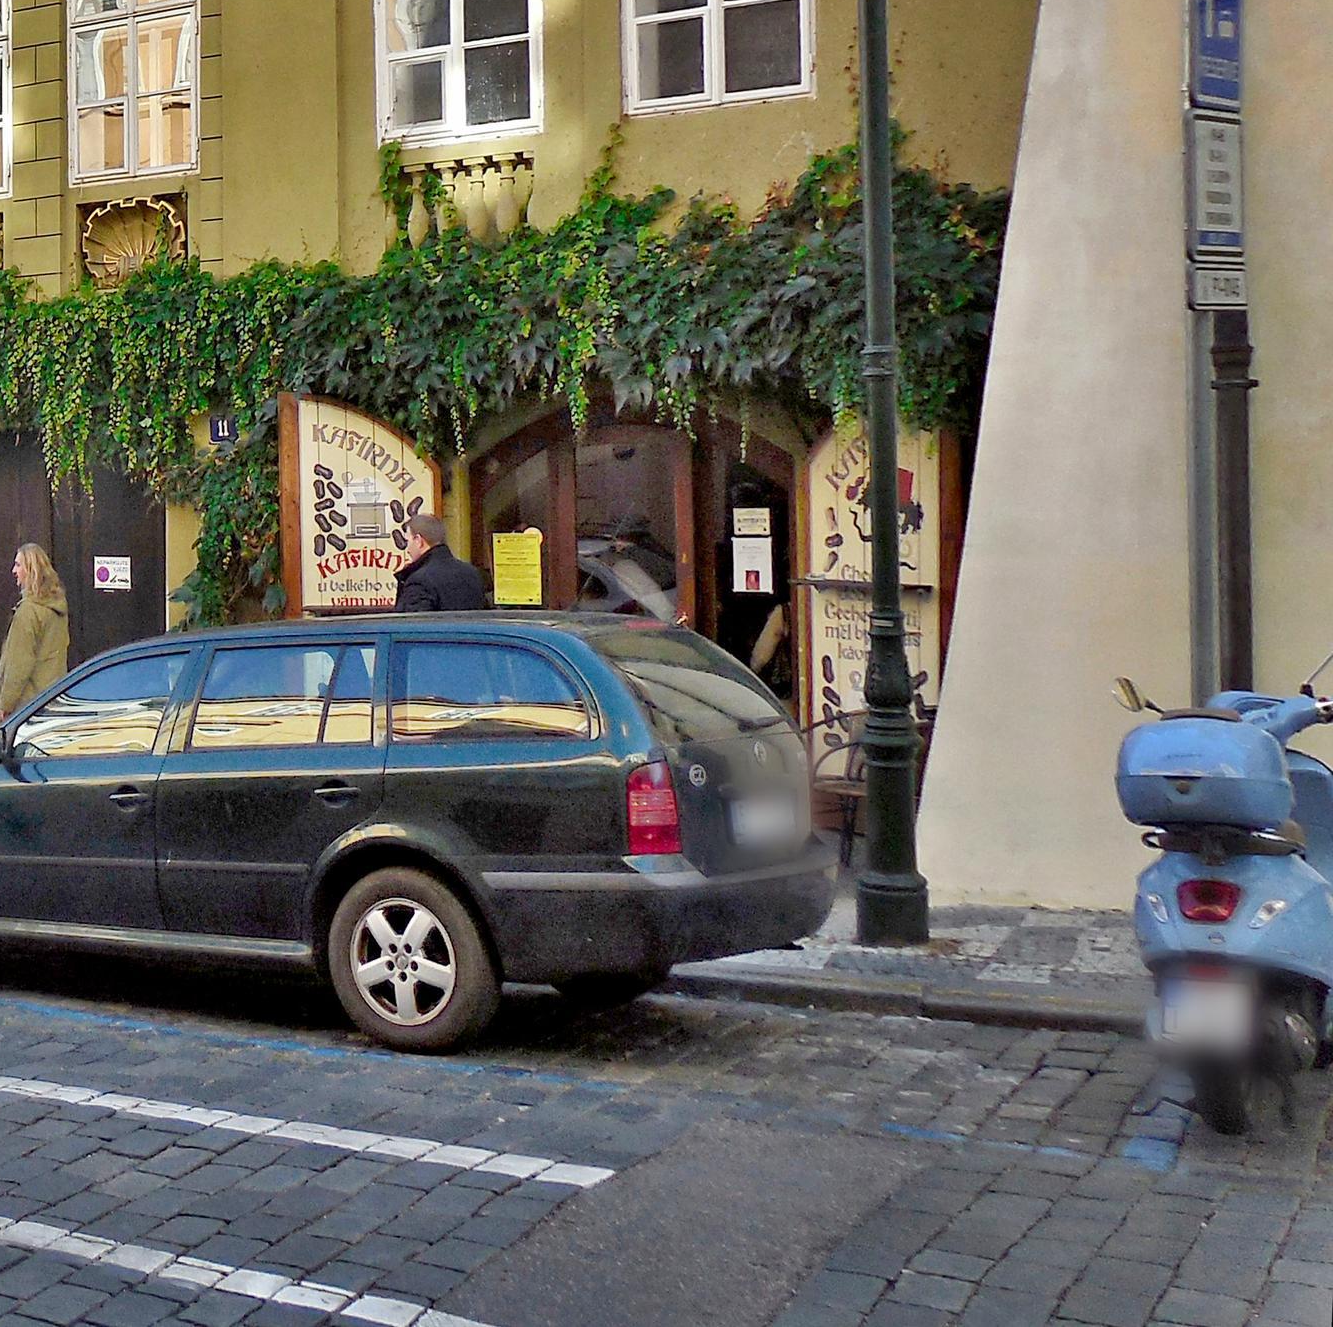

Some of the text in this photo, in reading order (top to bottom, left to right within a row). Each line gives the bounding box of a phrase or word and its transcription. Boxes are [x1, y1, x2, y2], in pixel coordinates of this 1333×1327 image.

[218, 419, 230, 437] 11
[312, 424, 416, 493] KAFÍRNA
[317, 546, 405, 579] KAFÍRN
